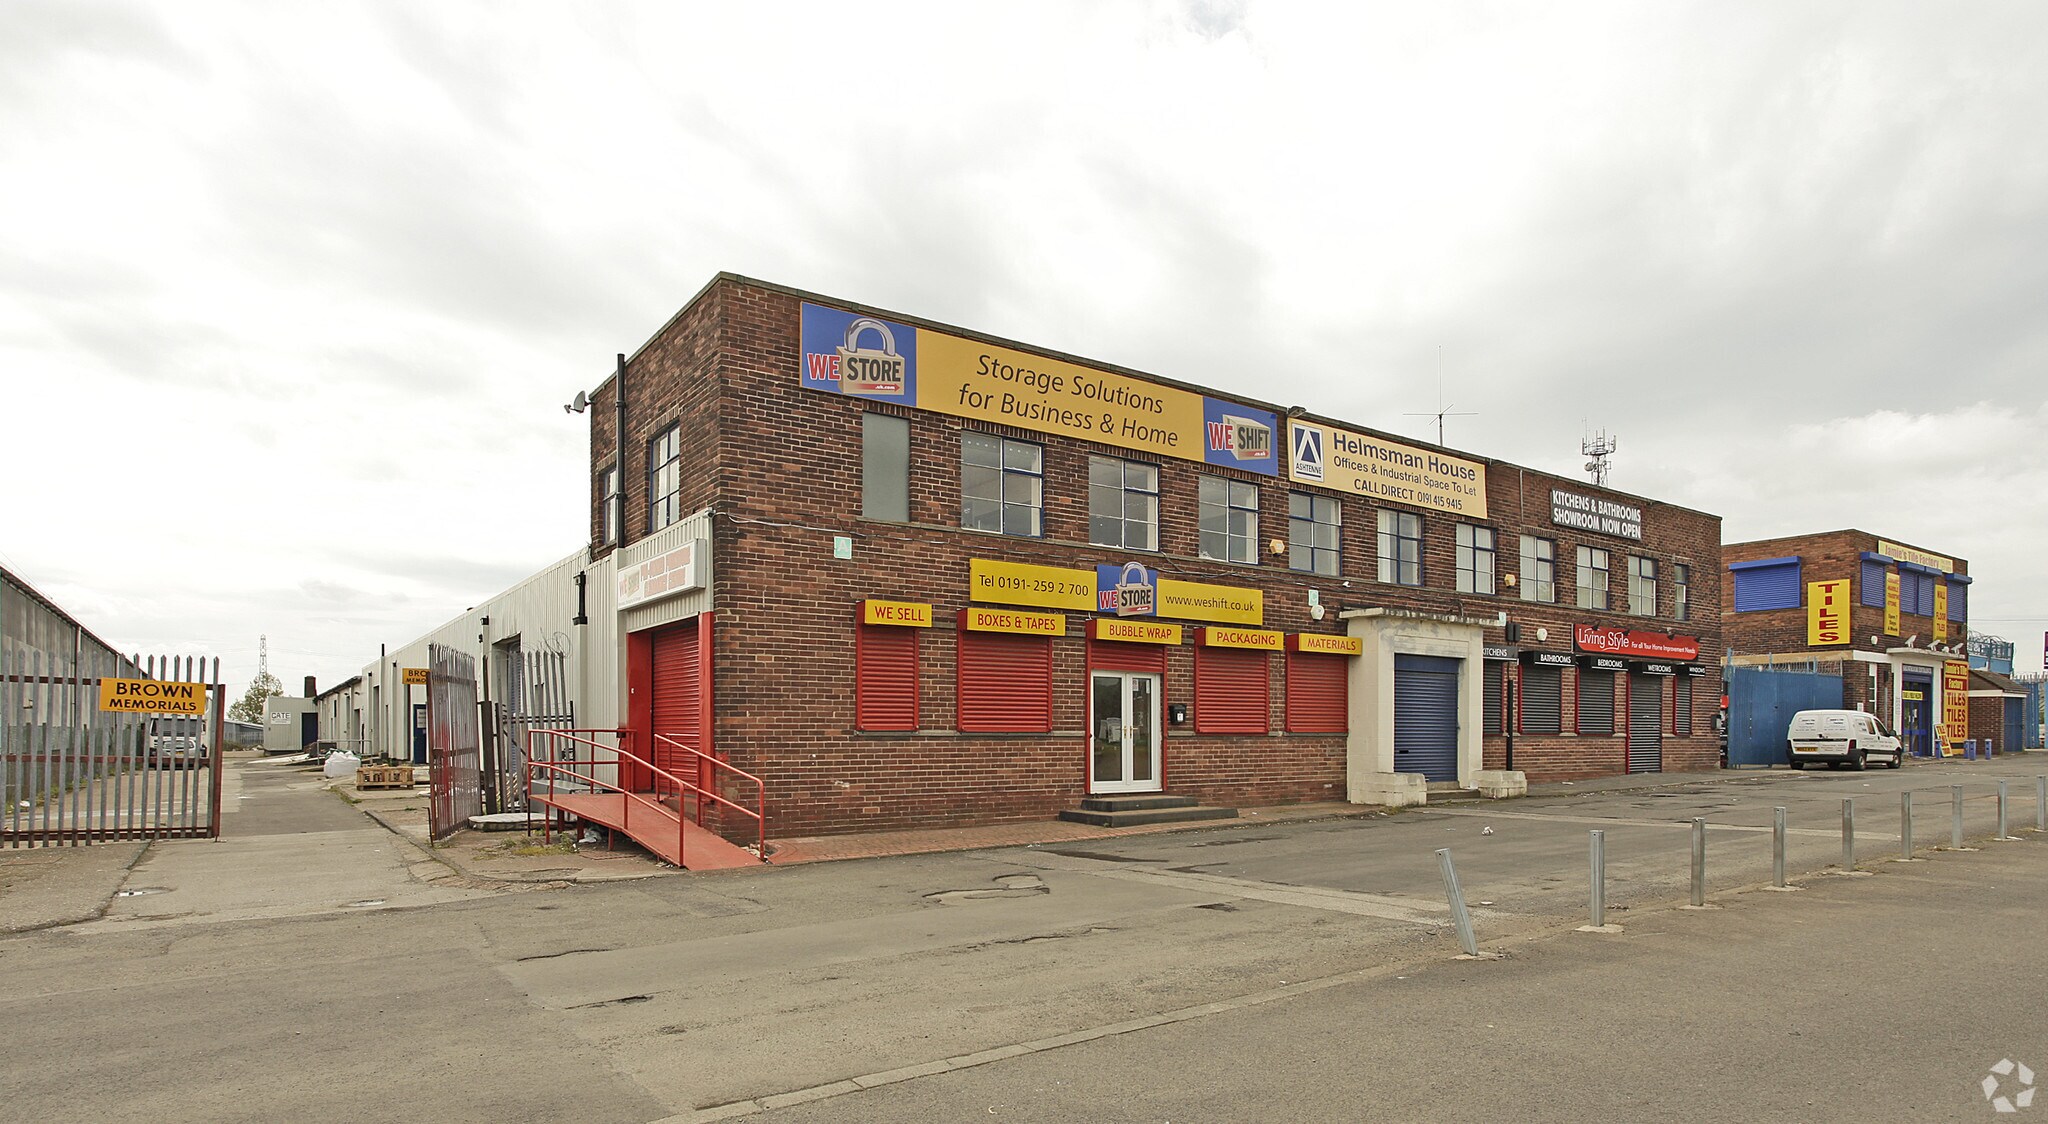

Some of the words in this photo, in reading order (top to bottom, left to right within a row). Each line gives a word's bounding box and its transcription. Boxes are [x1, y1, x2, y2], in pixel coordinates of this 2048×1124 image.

[807, 353, 841, 380] WE
[847, 357, 901, 382] STORE
[976, 354, 1064, 394] Storage
[1071, 375, 1164, 414] Solutions
[959, 383, 994, 410] for
[1000, 392, 1093, 430] Business
[1099, 413, 1115, 434] &
[1121, 417, 1178, 447] Home
[1207, 421, 1235, 451] WE
[1238, 426, 1269, 450] SHIFT
[1333, 432, 1424, 469] Helmsman
[1428, 455, 1476, 481] House
[1296, 462, 1322, 475] ASHTENNE
[1333, 455, 1369, 473] Offices
[1371, 463, 1378, 474] &
[1380, 466, 1422, 484] Industrial
[1423, 475, 1450, 491] Space
[1452, 481, 1462, 493] To
[1464, 484, 1476, 497] Let
[1354, 478, 1380, 494] CALL
[1381, 484, 1414, 500] DIRECT
[1417, 491, 1432, 504] 0191
[1433, 494, 1445, 507] 415
[1446, 497, 1463, 511] 9415
[1552, 490, 1589, 511] KITCHENS
[1591, 499, 1597, 513] &
[1599, 501, 1641, 522] BATHROOMS
[1553, 508, 1600, 530] SHOWROOM
[1602, 517, 1620, 535] NOW
[1621, 522, 1641, 539] OPEN
[837, 539, 849, 552] A
[1885, 544, 1907, 560] Jamie's
[1908, 551, 1919, 562] Tile
[1919, 554, 1939, 569] Factory
[979, 574, 994, 587] Tel
[998, 576, 1031, 590] 0191-
[1033, 580, 1055, 593] 259
[1058, 583, 1065, 594] 2
[1068, 583, 1089, 597] 700
[1099, 590, 1118, 609] WE
[1121, 590, 1151, 607] STORE
[1165, 595, 1255, 612] www.weshift.co.uk
[875, 606, 894, 620] WE
[897, 608, 925, 622] SELL
[1818, 583, 1839, 642] TILES
[977, 614, 1011, 628] BOXES
[1014, 617, 1022, 628] &
[1024, 617, 1056, 631] TAPES
[1109, 625, 1144, 638] BUBBLE
[1146, 627, 1172, 640] WRAP
[1216, 632, 1276, 646] PACKAGING
[1579, 628, 1606, 649] Living
[1607, 631, 1630, 650] Style
[1307, 638, 1356, 651] MATERIALS
[1540, 653, 1571, 664] BATHROOMS
[1597, 659, 1623, 668] BEDROOMS
[1647, 664, 1672, 673] WETROOMS
[116, 682, 193, 698] BROWN
[1946, 691, 1966, 706] TILES
[109, 698, 197, 711] MEMORIALS
[1946, 708, 1966, 723] TILES
[1946, 724, 1966, 738] TILES
